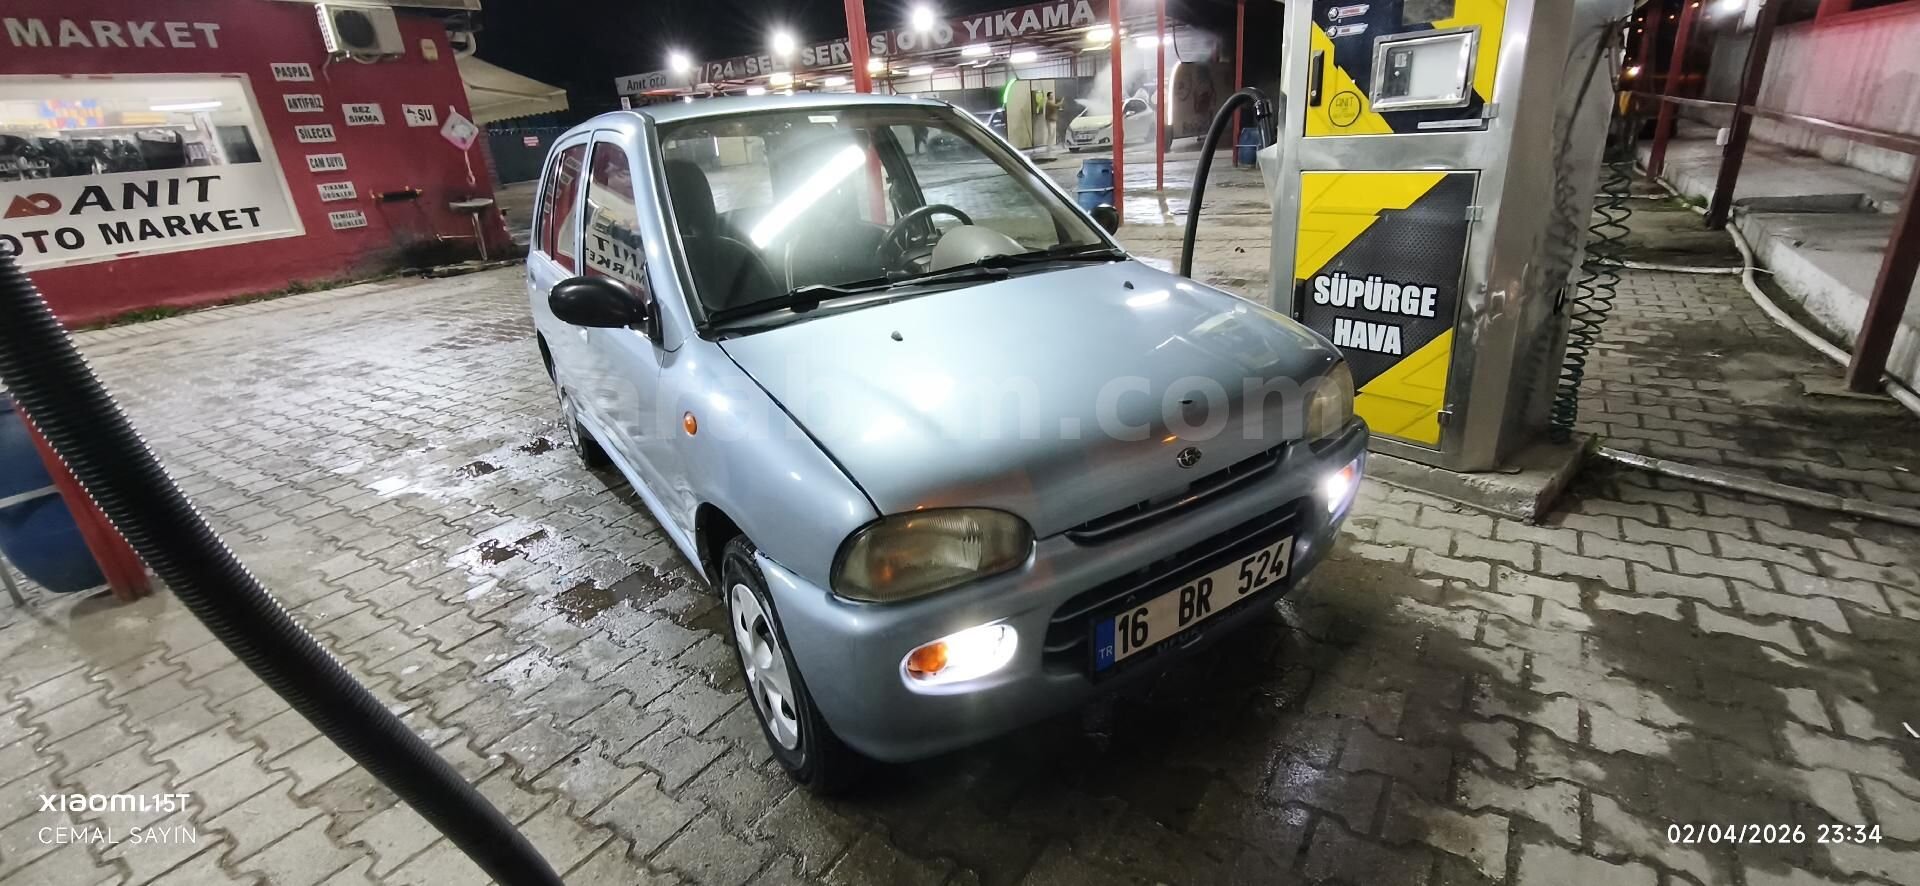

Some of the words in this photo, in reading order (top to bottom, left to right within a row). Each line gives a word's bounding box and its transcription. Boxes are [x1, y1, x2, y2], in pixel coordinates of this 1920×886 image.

[3, 18, 220, 48] MARKET
[745, 55, 792, 75] SEL
[963, 0, 1096, 39] YIKAMA
[274, 66, 310, 78] PASPAS
[417, 108, 432, 122] SU
[309, 158, 325, 169] CAM
[69, 175, 221, 216] ANIT
[0, 227, 85, 257] OTO
[98, 206, 261, 246] MARKET
[1313, 272, 1437, 318] SÜPÜRGE
[1333, 318, 1402, 355] HAVA
[1098, 645, 1113, 660] TR
[1118, 607, 1149, 654] 16
[1178, 576, 1214, 627] BR
[1238, 542, 1285, 595] 524
